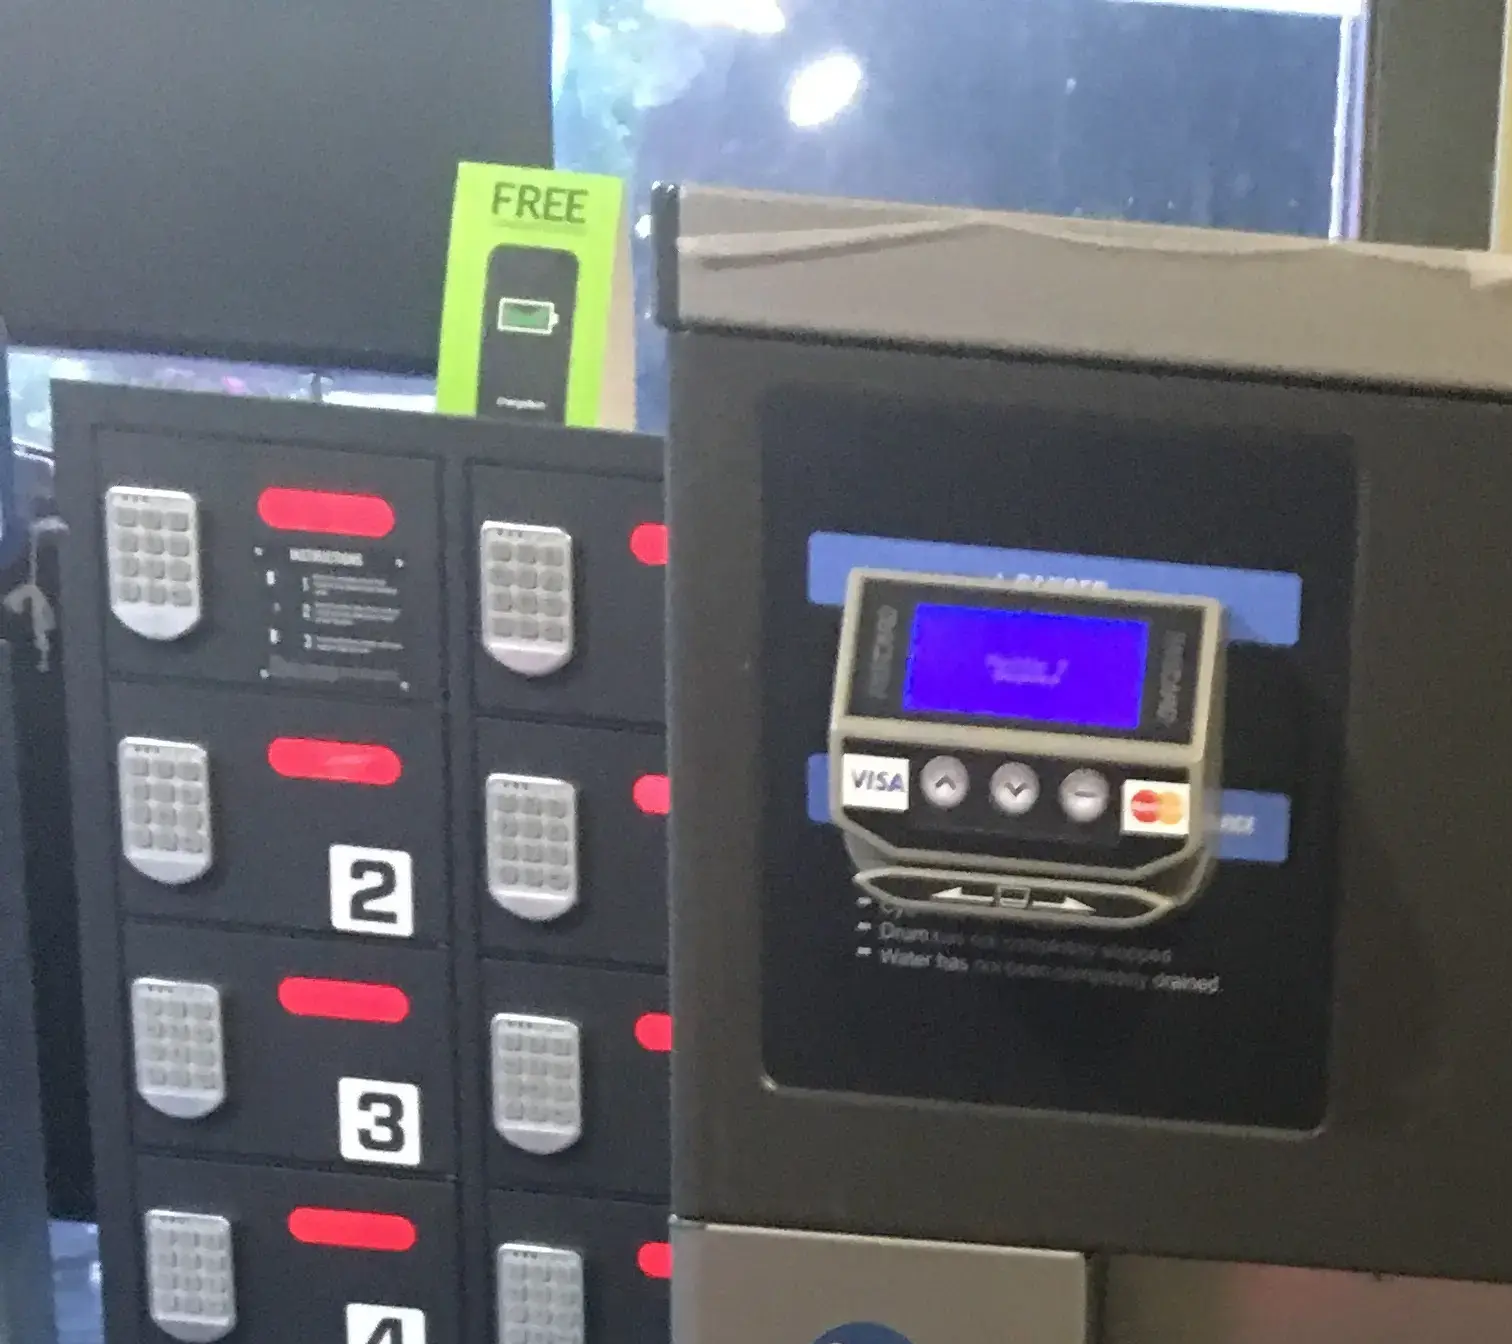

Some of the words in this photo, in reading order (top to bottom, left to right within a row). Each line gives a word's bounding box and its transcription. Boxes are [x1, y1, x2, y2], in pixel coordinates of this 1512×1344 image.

[492, 181, 590, 224] FREE
[851, 768, 906, 793] VISA
[348, 858, 398, 925] 2
[357, 1091, 406, 1154] 3
